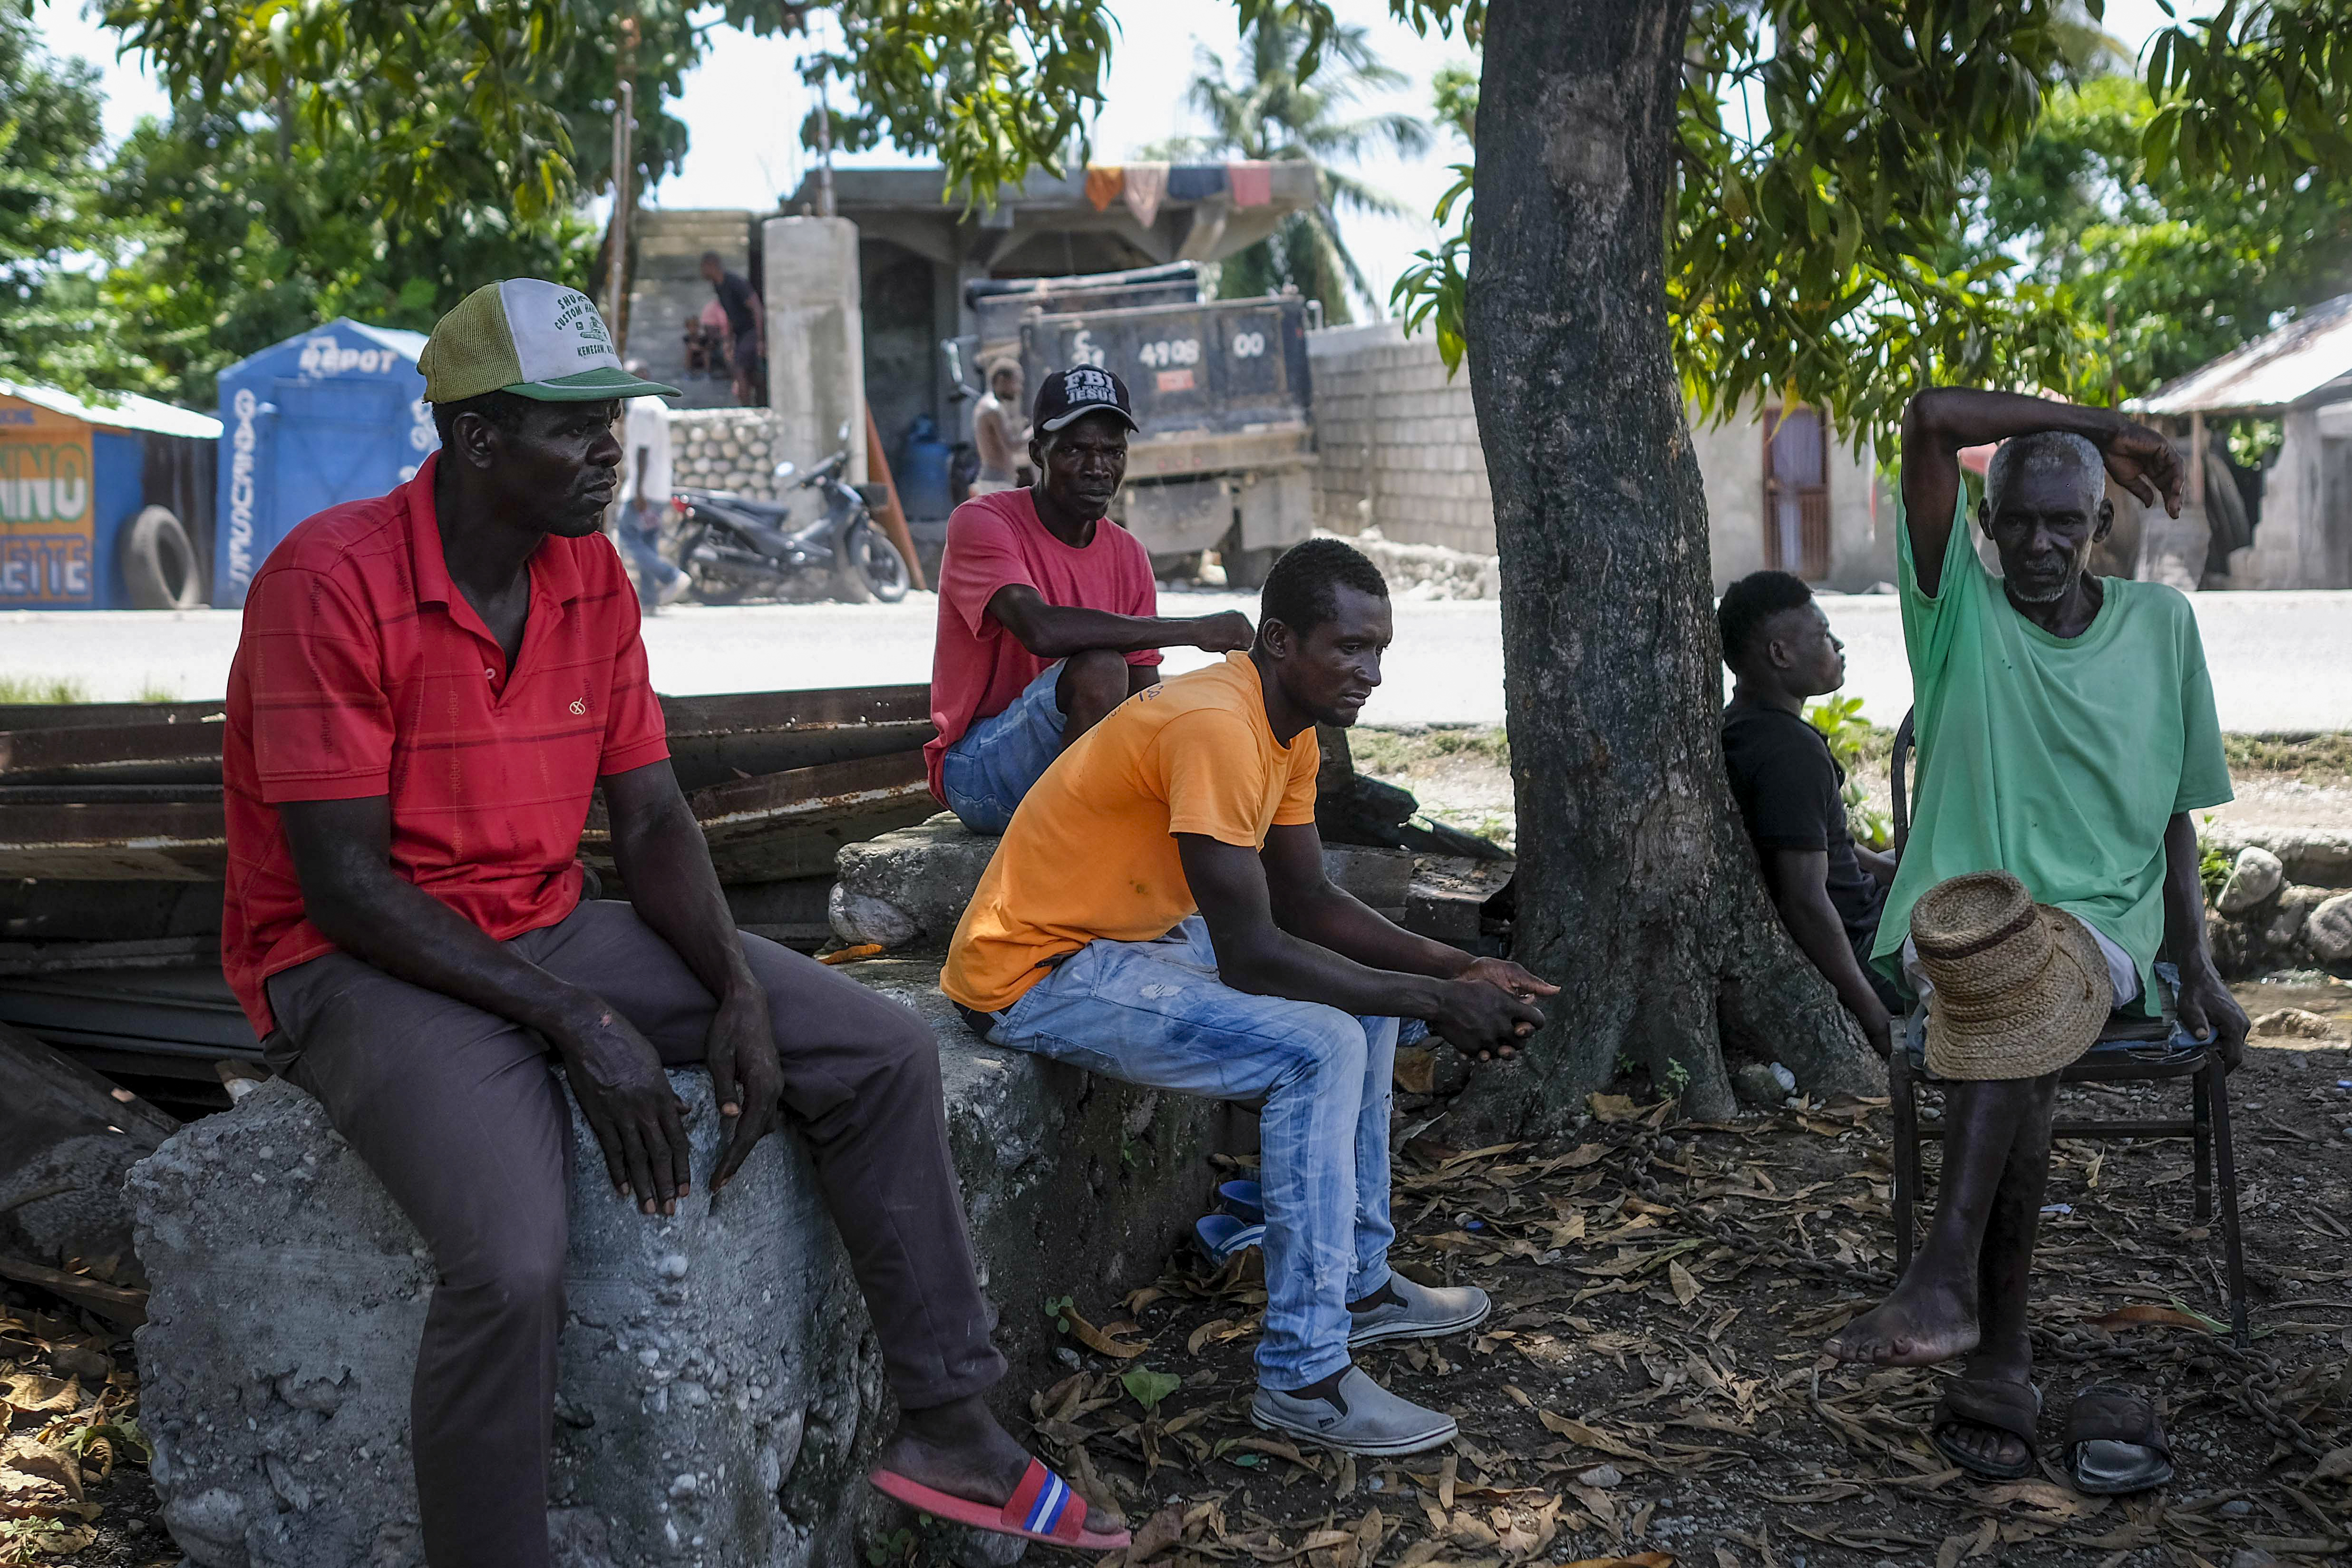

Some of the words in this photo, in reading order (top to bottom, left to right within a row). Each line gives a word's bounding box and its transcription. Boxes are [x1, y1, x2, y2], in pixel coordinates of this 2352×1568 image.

[554, 305, 583, 330] CUSTOM
[577, 344, 606, 357] KENESAW,
[1233, 331, 1265, 359] 00
[1064, 370, 1114, 390] FBI
[1068, 388, 1118, 404] JESUS
[0, 535, 89, 596] ETTE
